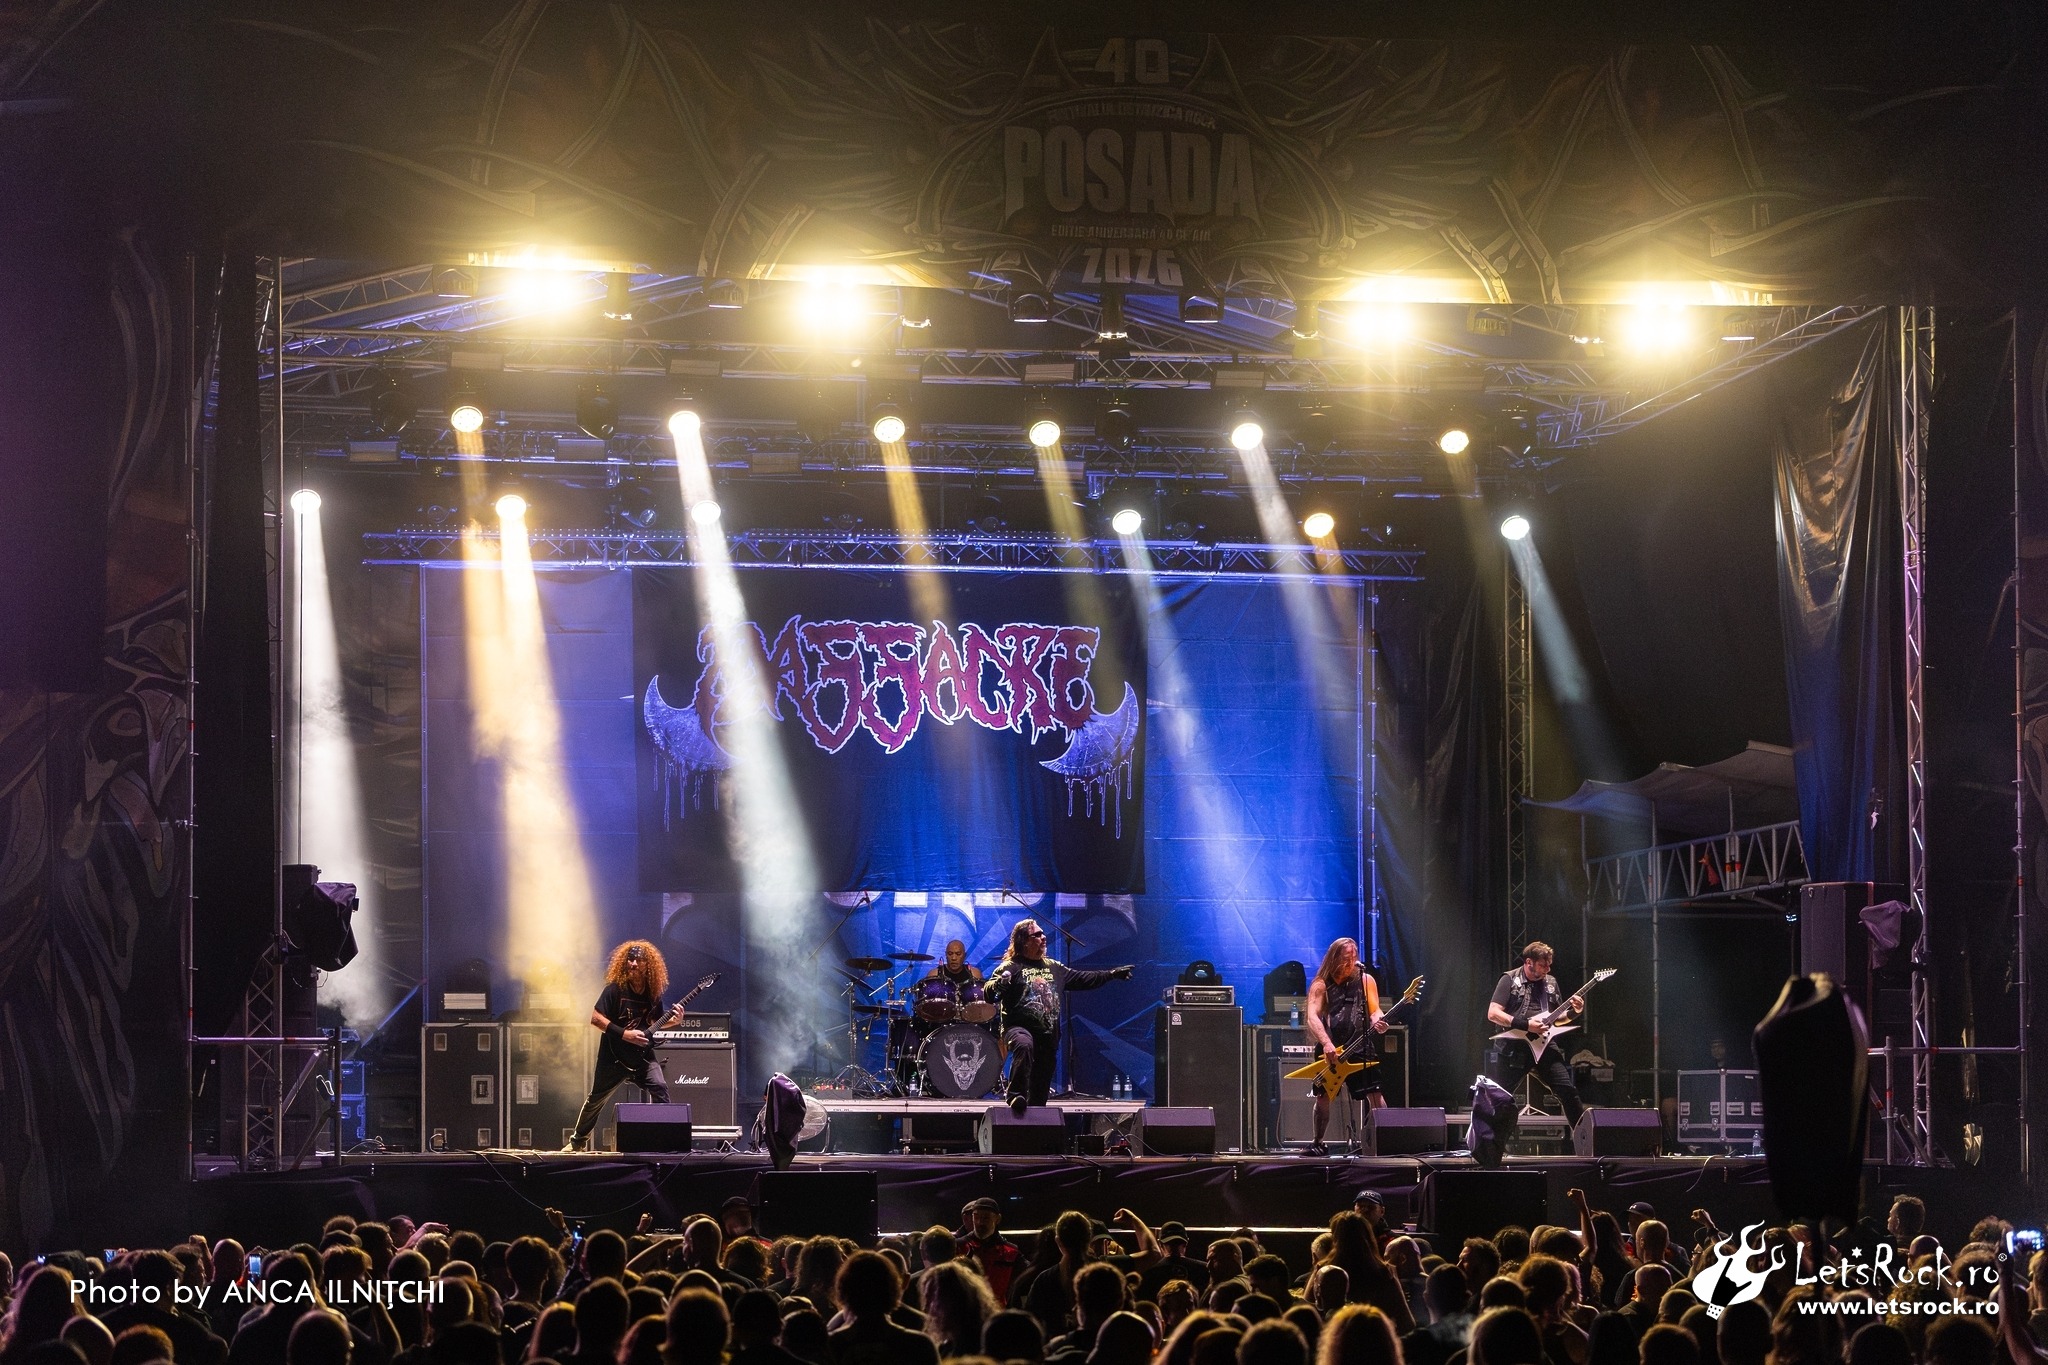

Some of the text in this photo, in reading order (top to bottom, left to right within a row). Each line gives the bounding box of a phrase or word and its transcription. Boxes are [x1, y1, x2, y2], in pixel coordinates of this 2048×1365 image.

[1094, 38, 1169, 84] 40
[1003, 125, 1262, 228] POSADA
[1082, 247, 1184, 286] 2026
[674, 1074, 710, 1085] Marshall
